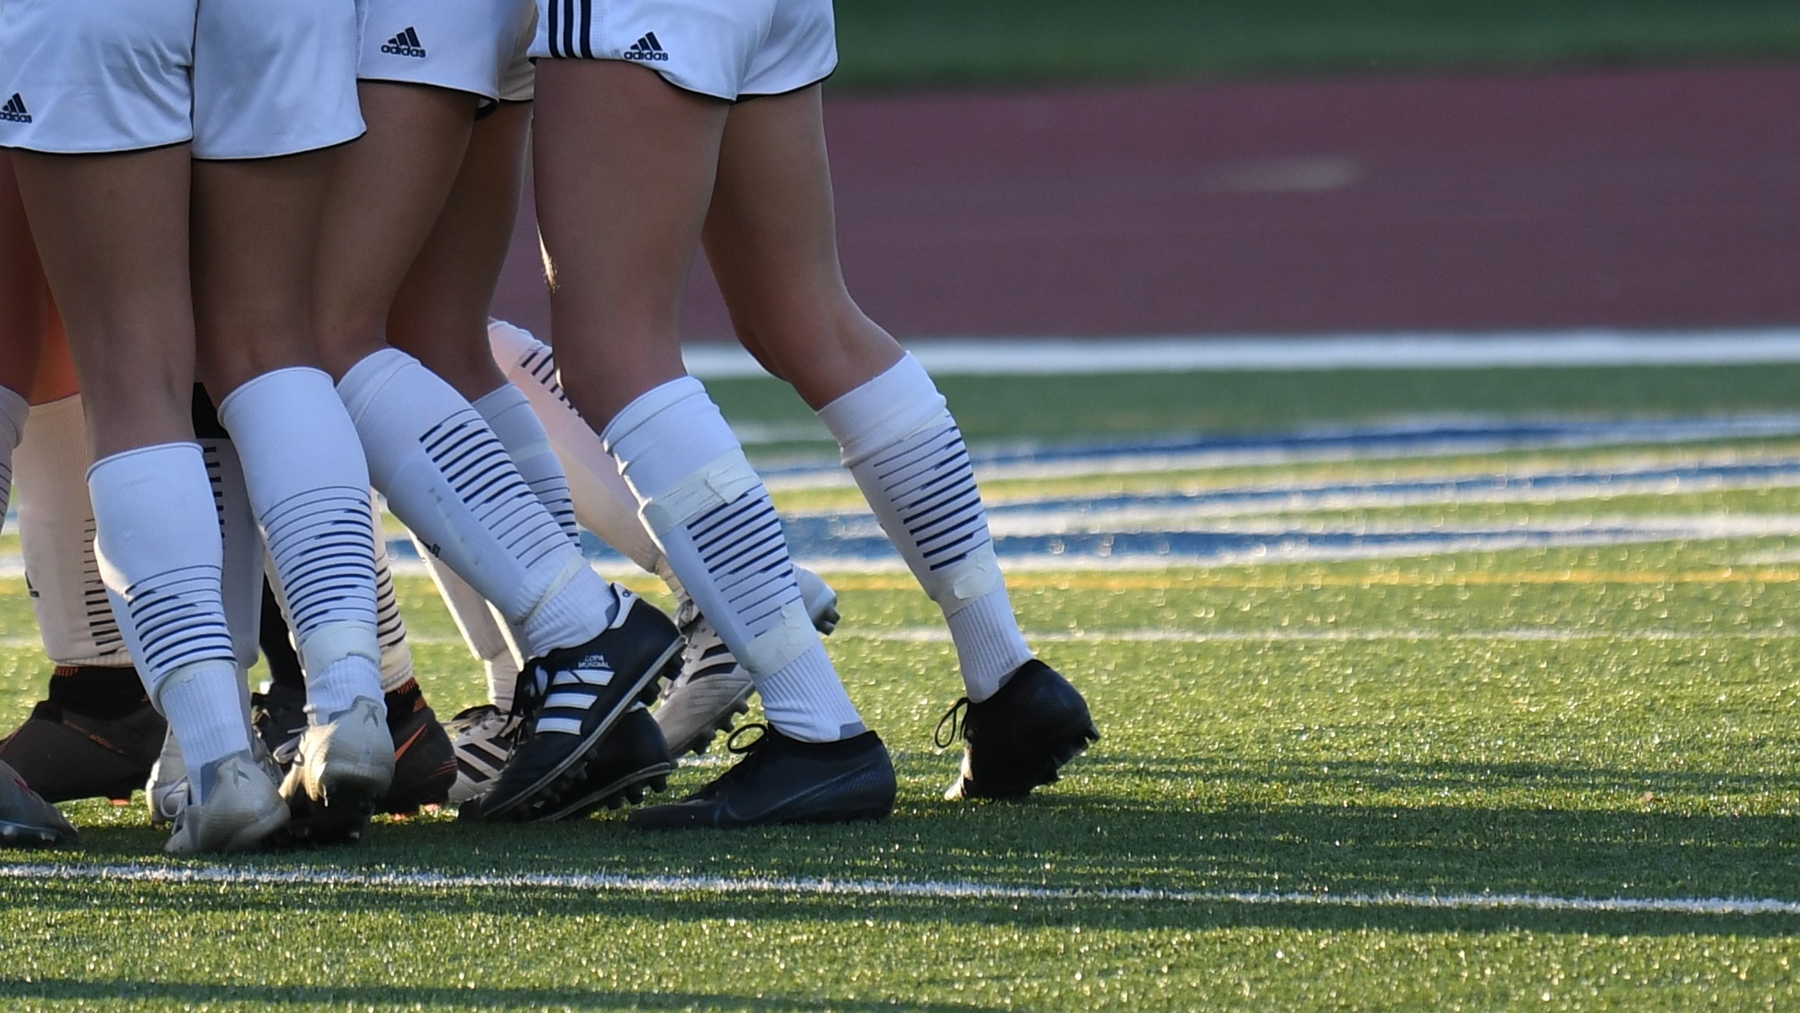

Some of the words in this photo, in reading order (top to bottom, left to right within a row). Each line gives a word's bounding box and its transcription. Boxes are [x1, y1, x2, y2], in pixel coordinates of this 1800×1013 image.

[381, 41, 427, 58] adidas
[624, 49, 669, 61] adidas
[584, 654, 605, 662] COPA
[578, 661, 610, 669] MUNDIAL
